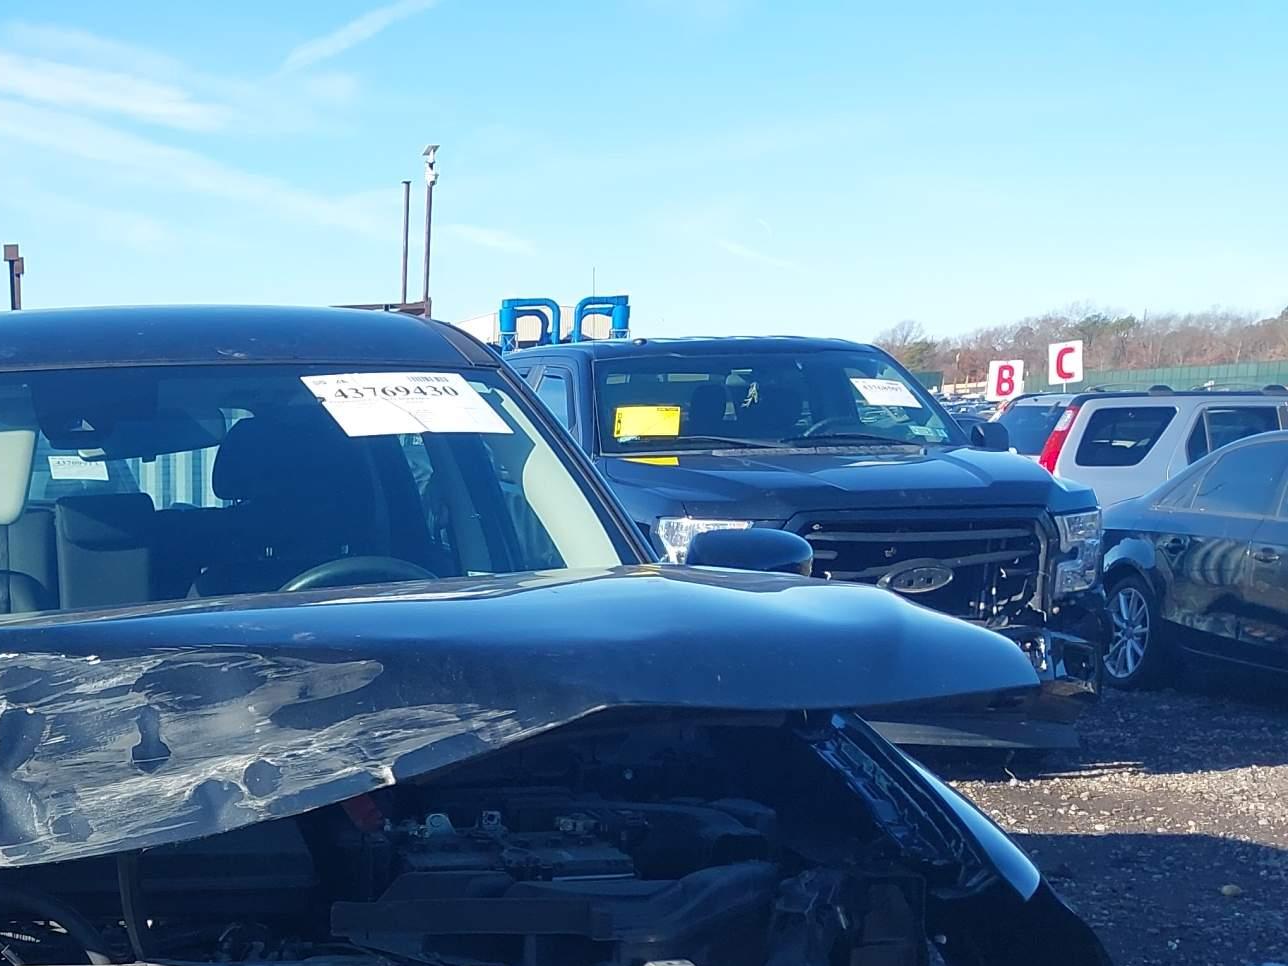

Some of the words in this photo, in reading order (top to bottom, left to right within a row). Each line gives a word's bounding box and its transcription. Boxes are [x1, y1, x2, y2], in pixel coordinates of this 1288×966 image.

[1055, 347, 1075, 380] C
[333, 384, 460, 400] 43769430
[995, 364, 1015, 397] B
